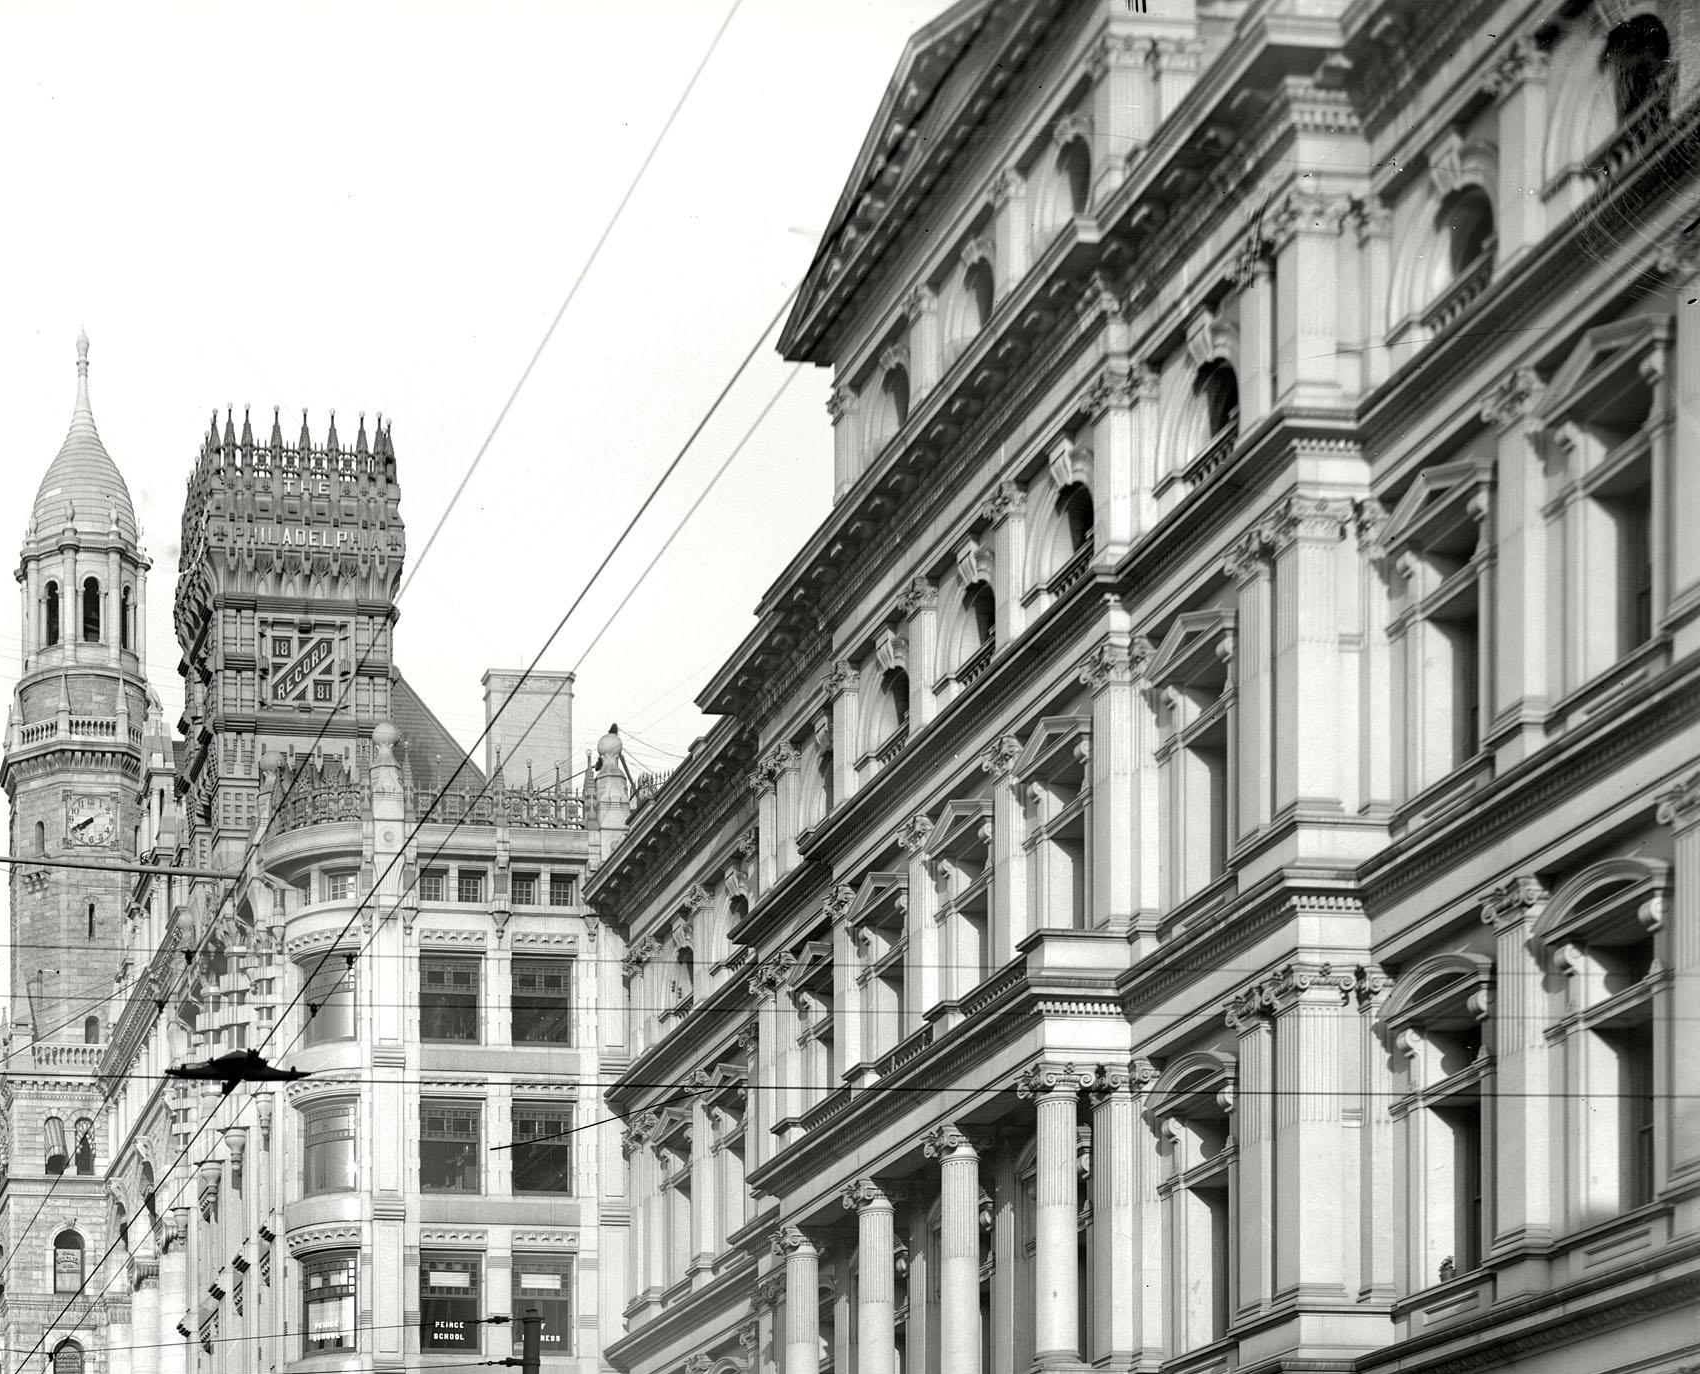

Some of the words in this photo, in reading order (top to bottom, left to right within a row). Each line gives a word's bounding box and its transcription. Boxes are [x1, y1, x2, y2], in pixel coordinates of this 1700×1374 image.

[283, 479, 331, 495] THE
[233, 526, 382, 550] PHILADELPHIA
[275, 640, 288, 656] 18
[277, 642, 327, 699] RECORD
[317, 684, 330, 699] 81
[434, 1321, 465, 1329] PEIRCE
[433, 1333, 465, 1341] SCHOOL
